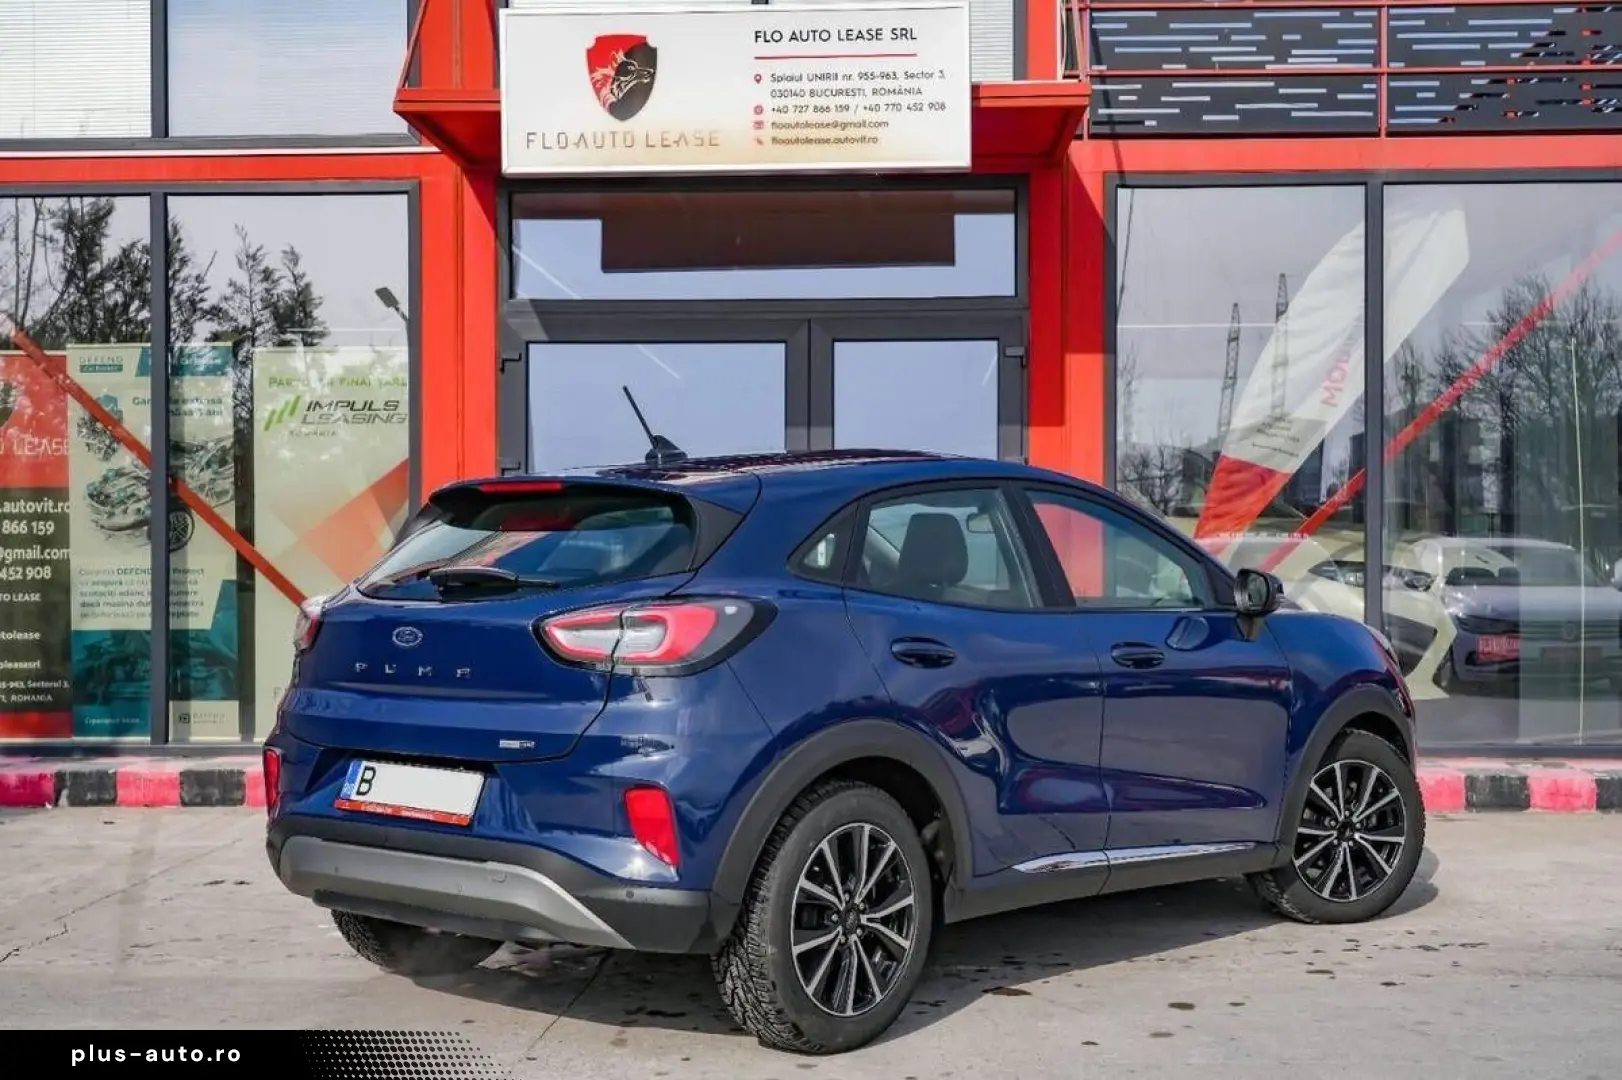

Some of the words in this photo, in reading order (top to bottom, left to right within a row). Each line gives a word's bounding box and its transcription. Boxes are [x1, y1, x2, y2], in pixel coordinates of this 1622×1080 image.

[754, 29, 783, 43] FLO
[788, 28, 833, 43] AUTO
[837, 28, 884, 42] LEASE
[890, 27, 918, 41] SRL
[770, 73, 803, 84] Splaiul
[903, 71, 934, 81] Sector
[770, 88, 806, 99] 030140
[871, 84, 923, 97] ROMÂNIA
[771, 105, 789, 114] +40
[792, 104, 809, 113] 727
[812, 104, 831, 113] 866
[834, 104, 850, 113] 159
[863, 103, 881, 112] +40
[884, 103, 902, 112] 770
[906, 102, 923, 112] 452
[927, 101, 947, 112] 908
[771, 119, 889, 131] floautolease@gmail.com
[525, 131, 569, 150] FLO
[645, 129, 721, 148] LEASE
[771, 135, 879, 146] floautolease.autovit.ro
[306, 399, 400, 412] IMPULS
[301, 413, 408, 425] LEASING
[2, 519, 28, 535] 866
[31, 520, 55, 536] 159
[0, 566, 23, 580] 452
[26, 565, 52, 580] 908
[12, 592, 42, 602] LEASE
[356, 765, 377, 796] B
